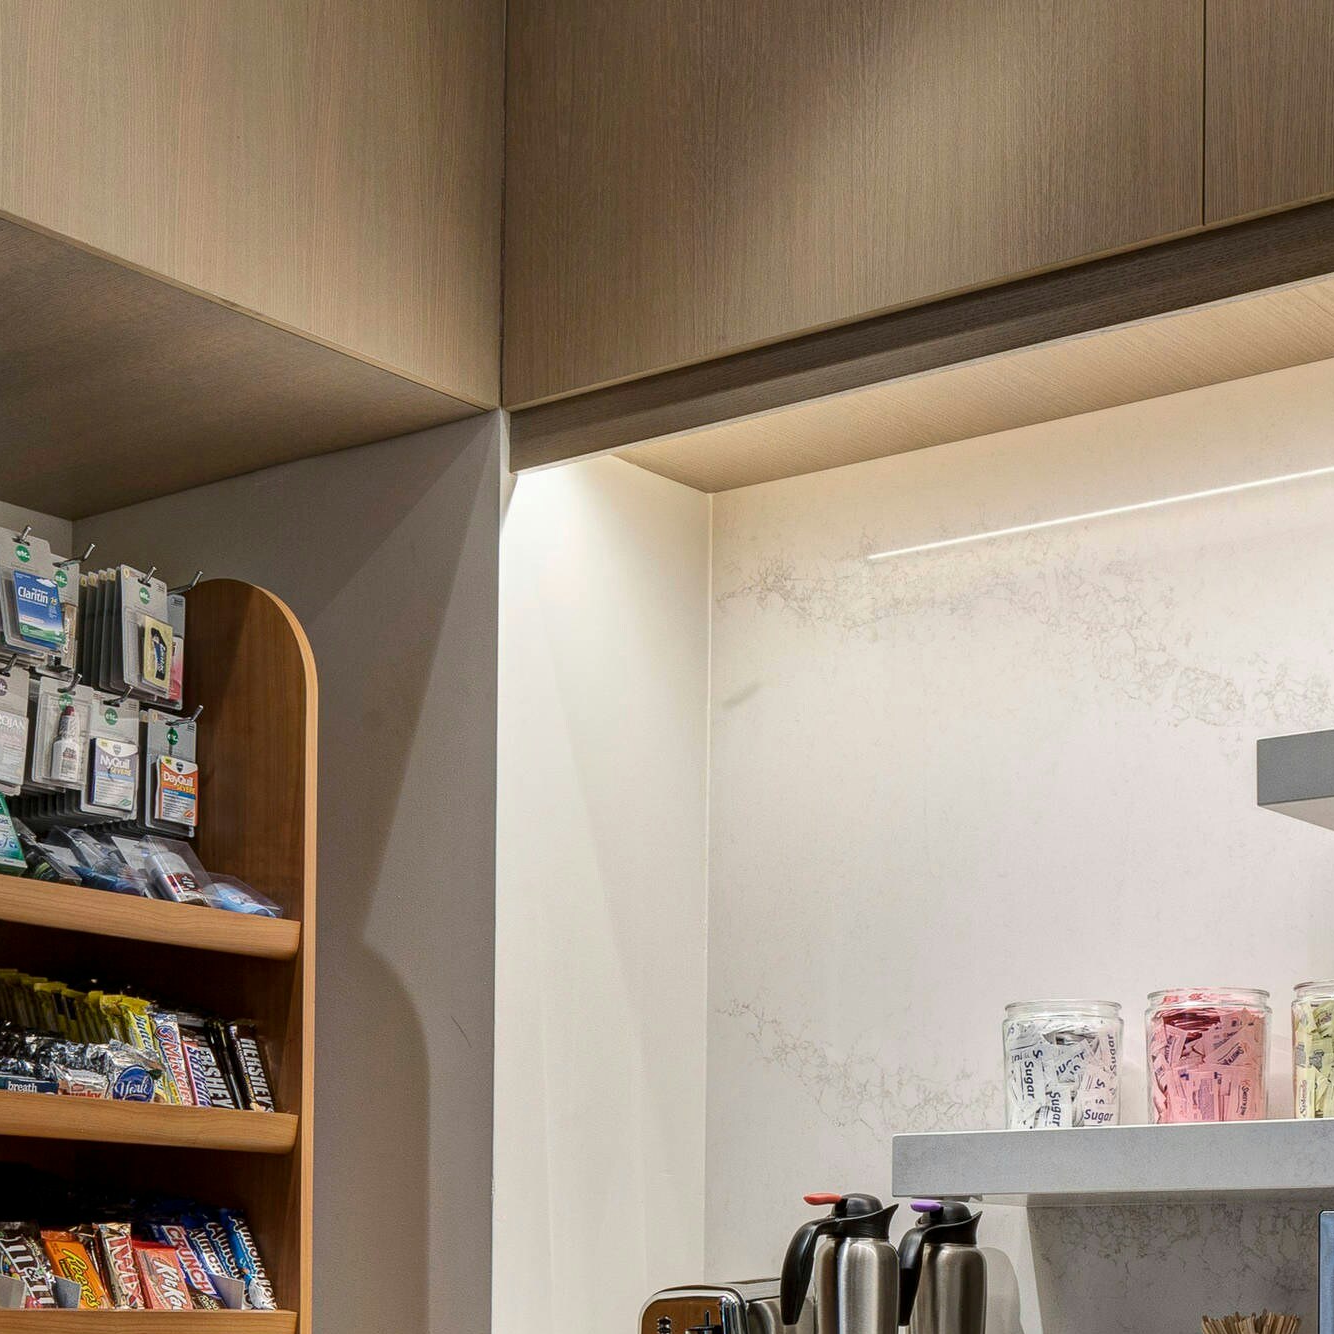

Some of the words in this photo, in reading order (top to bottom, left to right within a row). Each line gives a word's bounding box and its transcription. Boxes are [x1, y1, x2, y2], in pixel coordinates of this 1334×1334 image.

[16, 548, 31, 560] etc.
[17, 585, 49, 605] Claritin
[105, 712, 119, 723] etc.
[99, 754, 131, 772] NyQuil
[163, 771, 194, 787] DayQuil
[7, 1080, 38, 1094] breath
[1024, 1060, 1036, 1099] Sugar
[1049, 1091, 1062, 1128] Sugar
[1084, 1108, 1114, 1124] Sugar
[166, 1227, 217, 1296] CRUNCH
